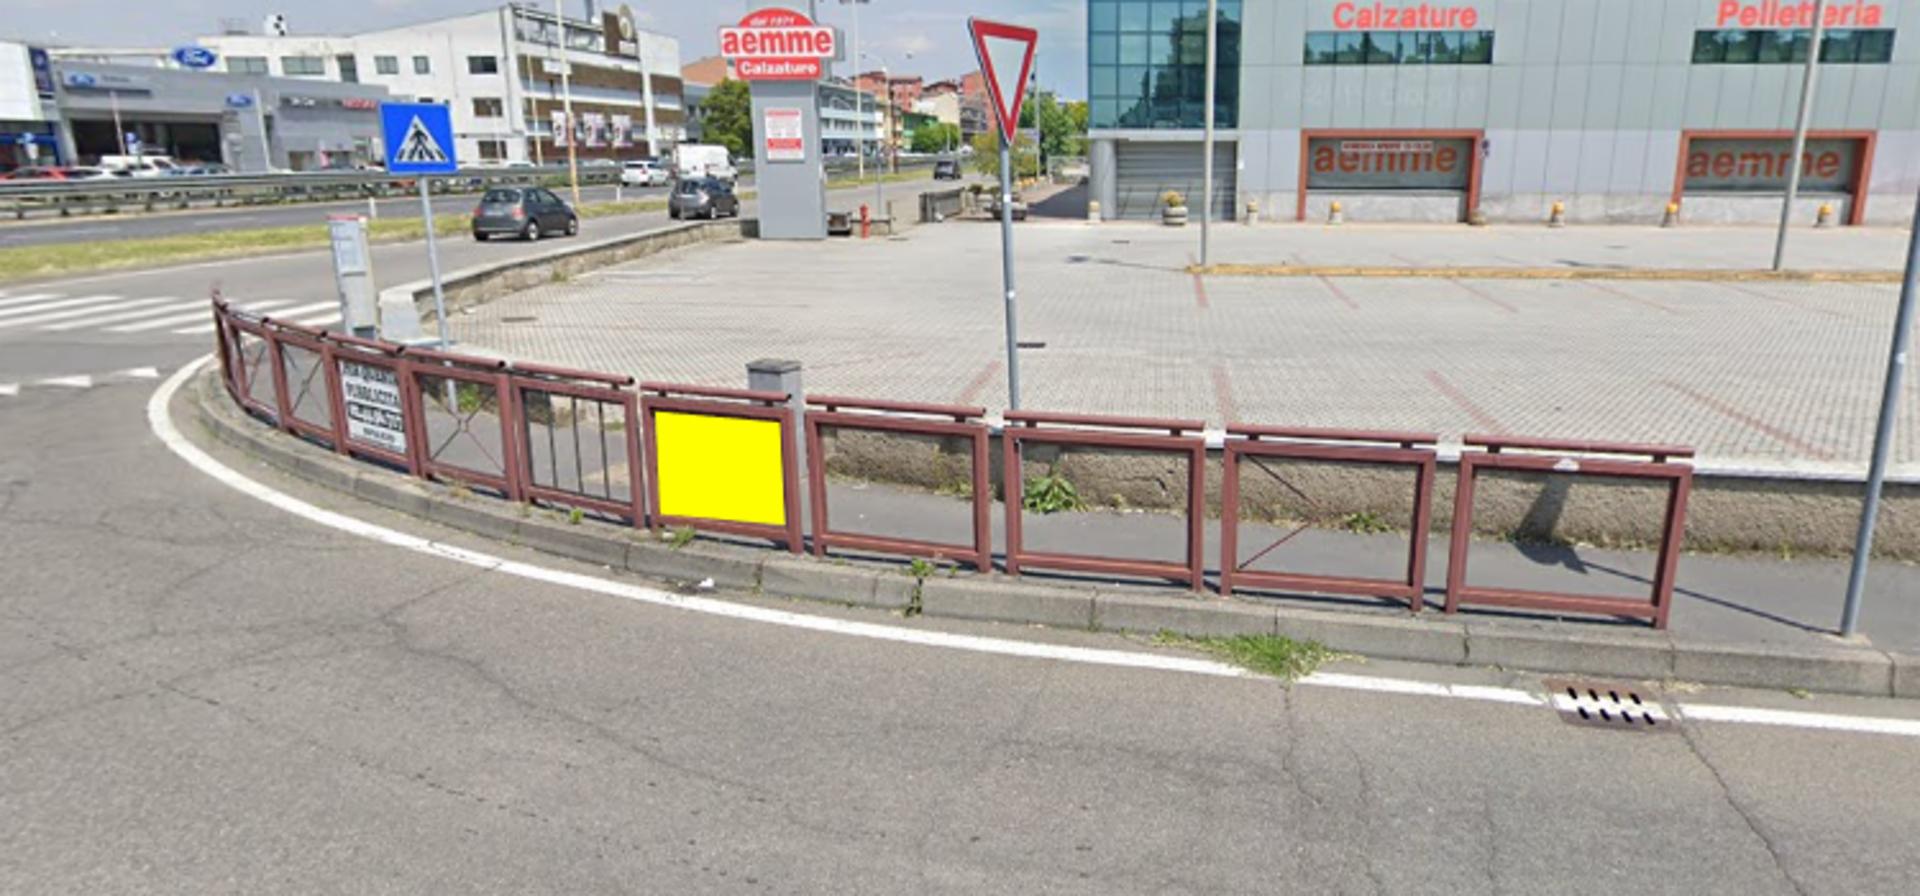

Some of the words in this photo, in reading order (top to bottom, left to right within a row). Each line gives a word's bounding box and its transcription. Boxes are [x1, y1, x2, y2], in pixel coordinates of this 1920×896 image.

[1333, 3, 1477, 29] Calzature
[1717, 0, 1881, 26] Pelleteria
[723, 30, 832, 54] aemme
[741, 62, 817, 75] Calzature
[1314, 145, 1457, 173] aemme
